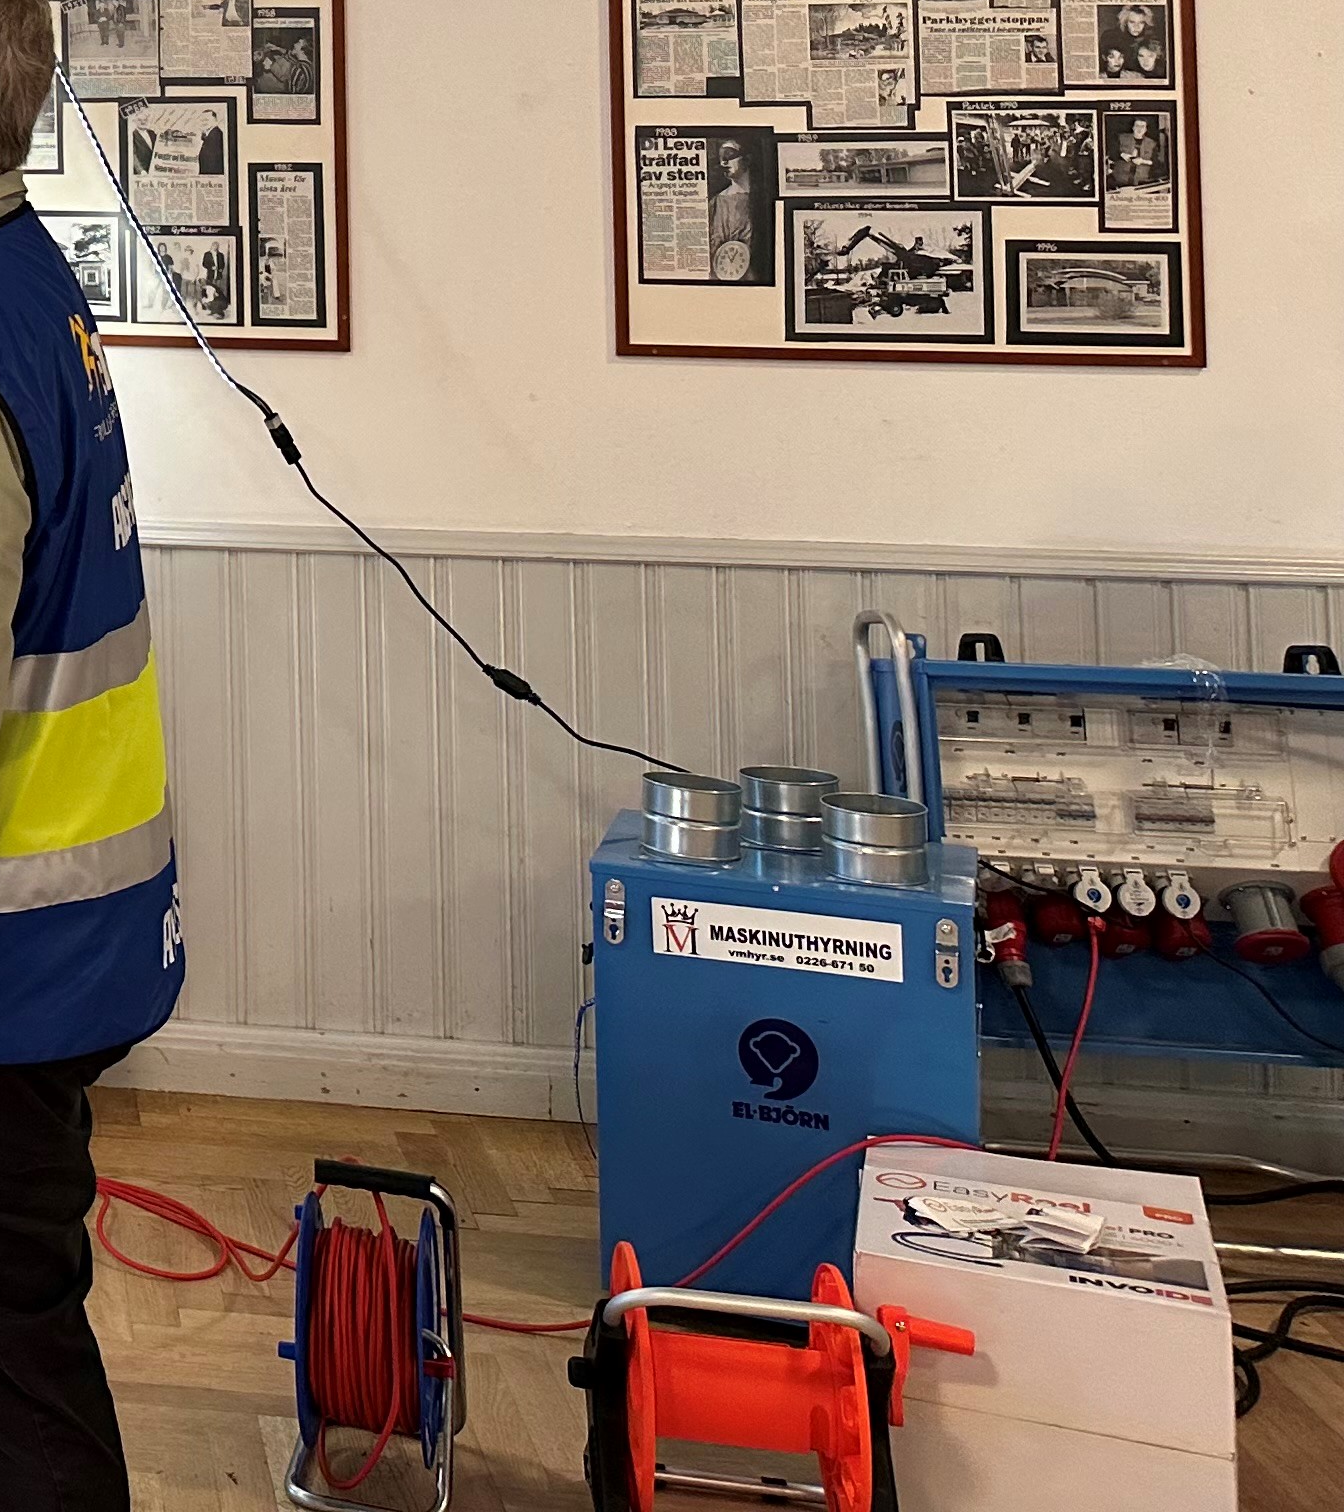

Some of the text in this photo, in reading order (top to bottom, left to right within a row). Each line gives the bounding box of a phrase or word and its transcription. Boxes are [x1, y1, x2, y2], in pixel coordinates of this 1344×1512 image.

[922, 15, 1050, 25] Parkbygget stoppas
[641, 138, 705, 151] Di Leva
[641, 153, 700, 167] träffad
[641, 168, 706, 181] av sten
[709, 924, 892, 961] MASKINUTHYRNING
[728, 948, 785, 963] vmhyr.se
[1128, 1227, 1175, 1239] PRO
